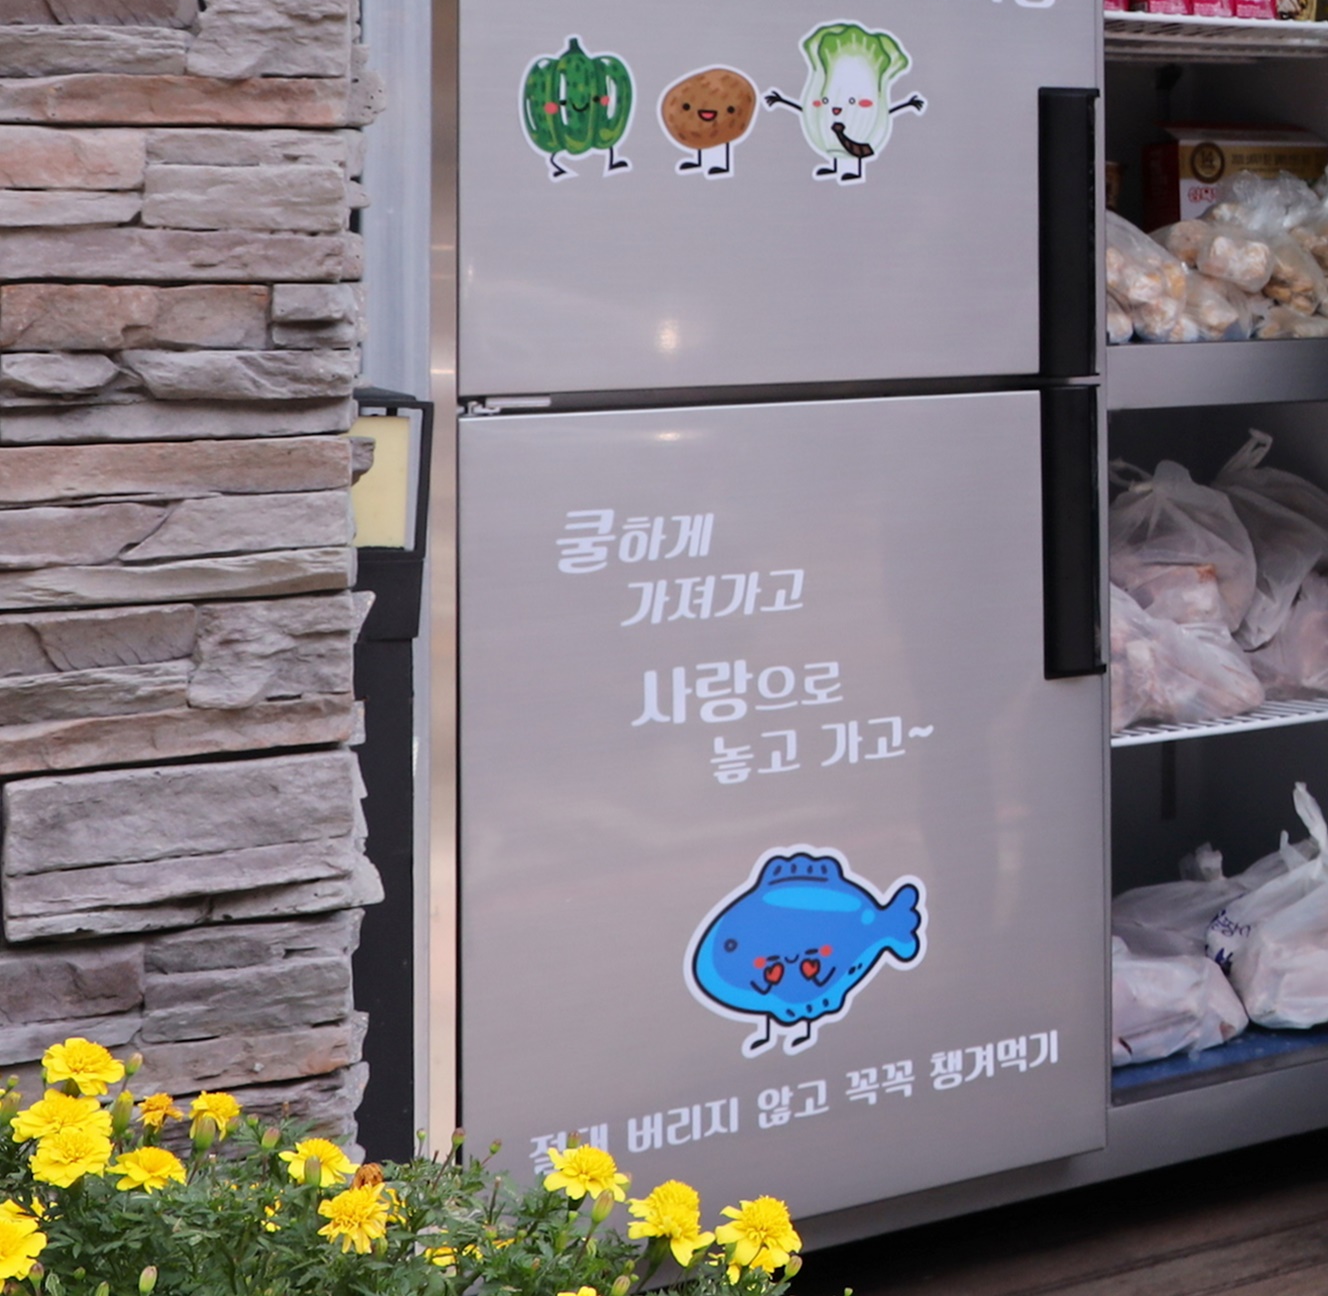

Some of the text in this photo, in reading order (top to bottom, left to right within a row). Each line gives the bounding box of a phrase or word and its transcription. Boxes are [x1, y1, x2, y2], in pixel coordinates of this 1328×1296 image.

[555, 508, 715, 574] 쿨하게
[620, 568, 805, 628] 가져가고
[630, 659, 844, 728] 사랑으로
[709, 729, 800, 786] 놓고
[626, 1097, 740, 1154] 버리지
[756, 1080, 829, 1131] 않고
[844, 1059, 915, 1106] 꼭꼭
[929, 1029, 1059, 1091] 챙겨먹기
